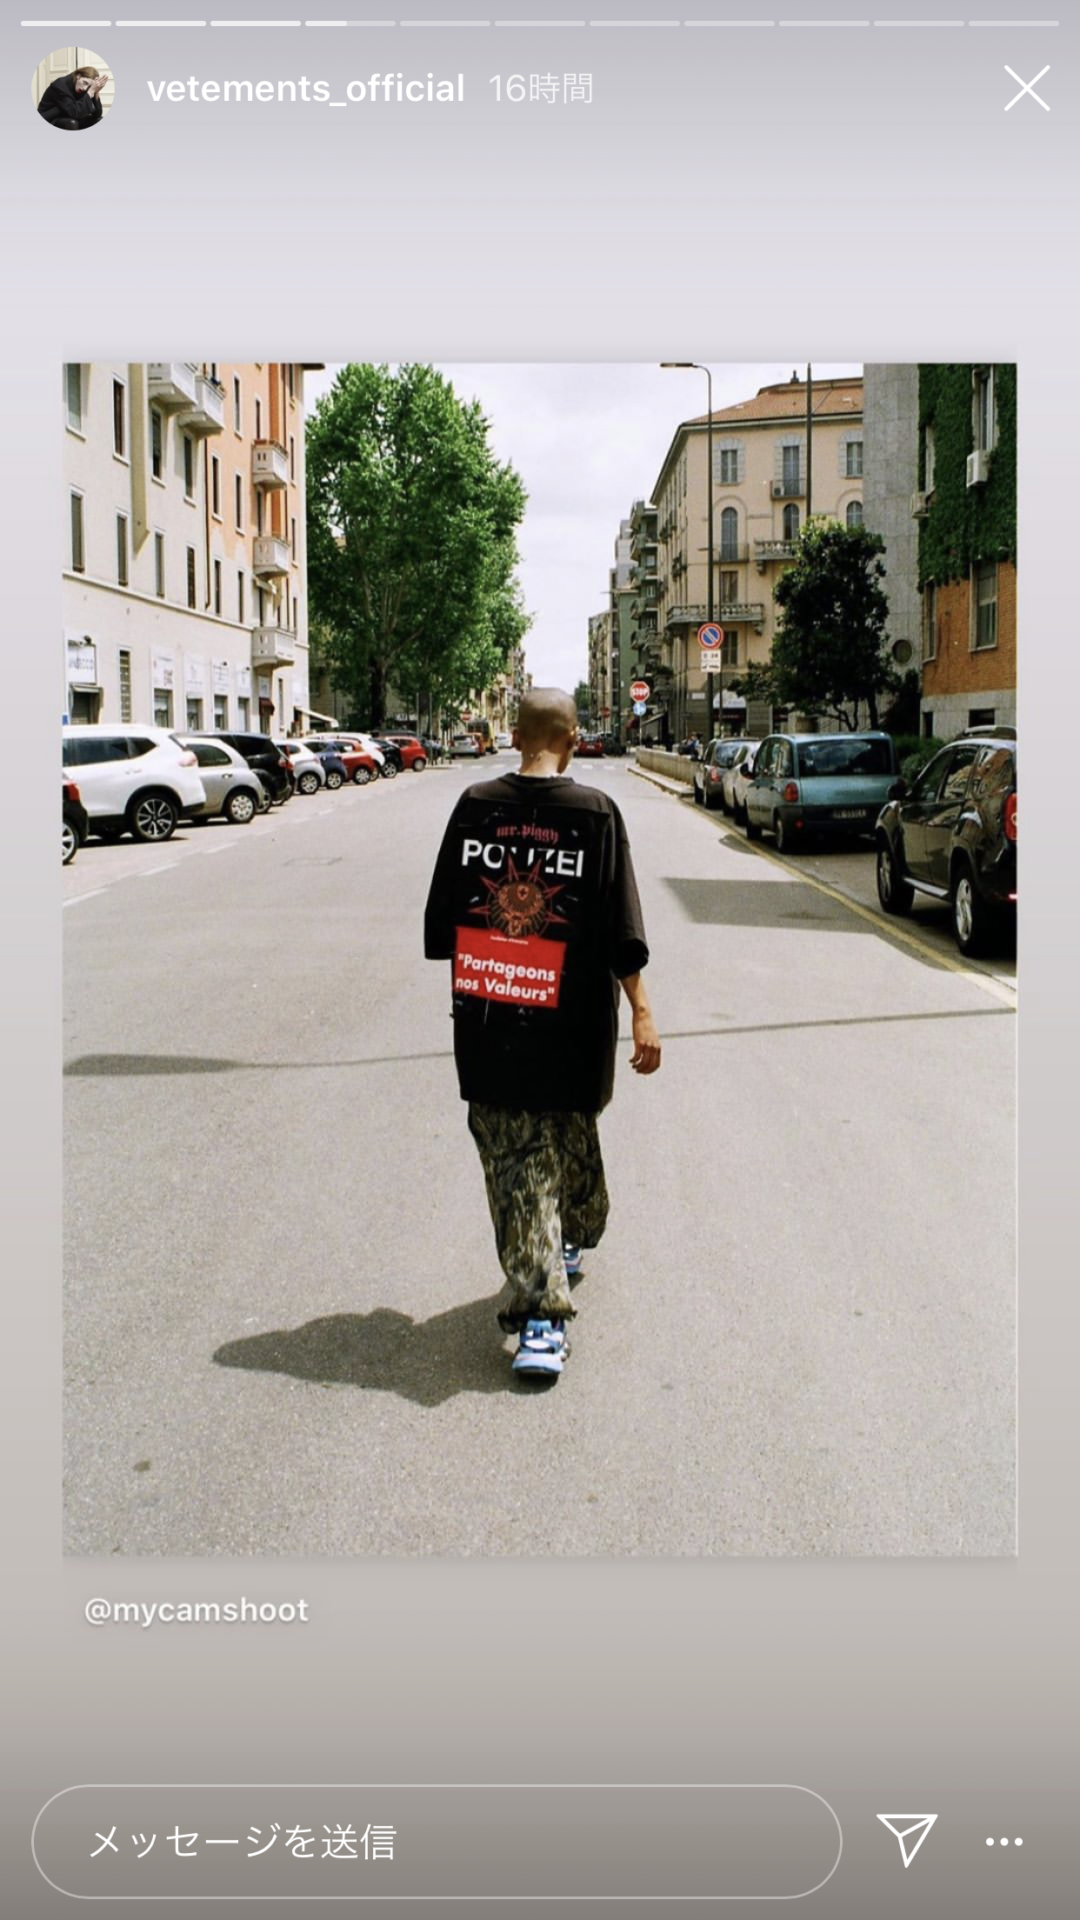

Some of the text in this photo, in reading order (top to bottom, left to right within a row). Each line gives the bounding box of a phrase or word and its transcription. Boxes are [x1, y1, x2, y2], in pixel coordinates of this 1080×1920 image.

[458, 952, 556, 981] "Partageons
[456, 977, 555, 1001] nos Valeurs"
